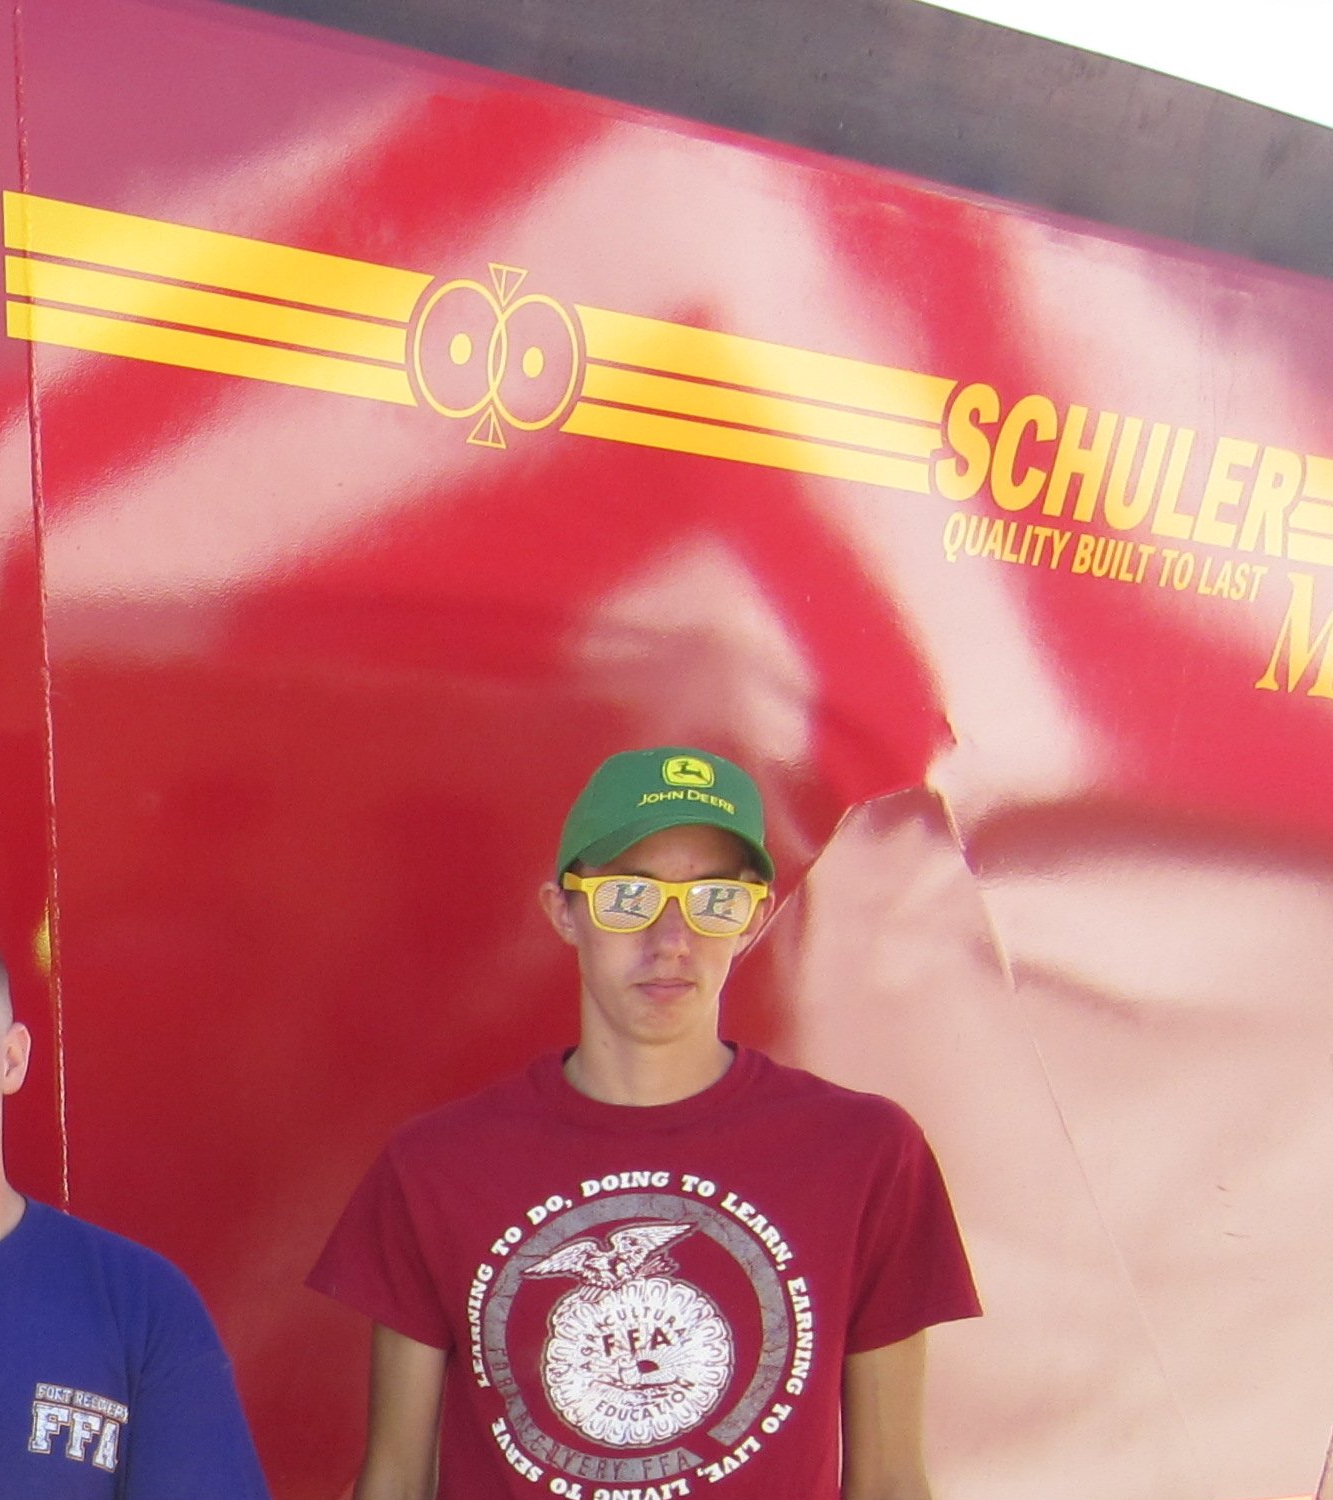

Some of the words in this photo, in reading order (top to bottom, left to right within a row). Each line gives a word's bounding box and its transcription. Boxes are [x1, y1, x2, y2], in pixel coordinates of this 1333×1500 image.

[935, 382, 1303, 558] SCHULER
[942, 511, 1071, 570] QUALITY
[1072, 533, 1156, 585] BUILT
[1158, 549, 1197, 591] TO
[1197, 558, 1269, 603] LAST
[637, 789, 684, 808] JOHN
[687, 789, 735, 815] DEERE
[580, 1171, 671, 1198] DOING
[681, 1173, 716, 1198] TO
[526, 1194, 574, 1227] DO,
[490, 1225, 523, 1257] TO
[720, 1192, 796, 1273] LEARN,
[467, 1262, 495, 1389] LEARNING
[580, 1306, 693, 1373] AGRICULTURAL
[601, 1327, 672, 1358] FFA
[785, 1276, 814, 1397] EARNING
[35, 1382, 73, 1404] FORT
[595, 1380, 696, 1420] EDUCATION
[28, 1400, 120, 1474] FFA
[760, 1403, 793, 1435] TO
[490, 1416, 544, 1484] SERVE
[641, 1450, 690, 1480] FFA
[696, 1435, 763, 1485] LIVE,
